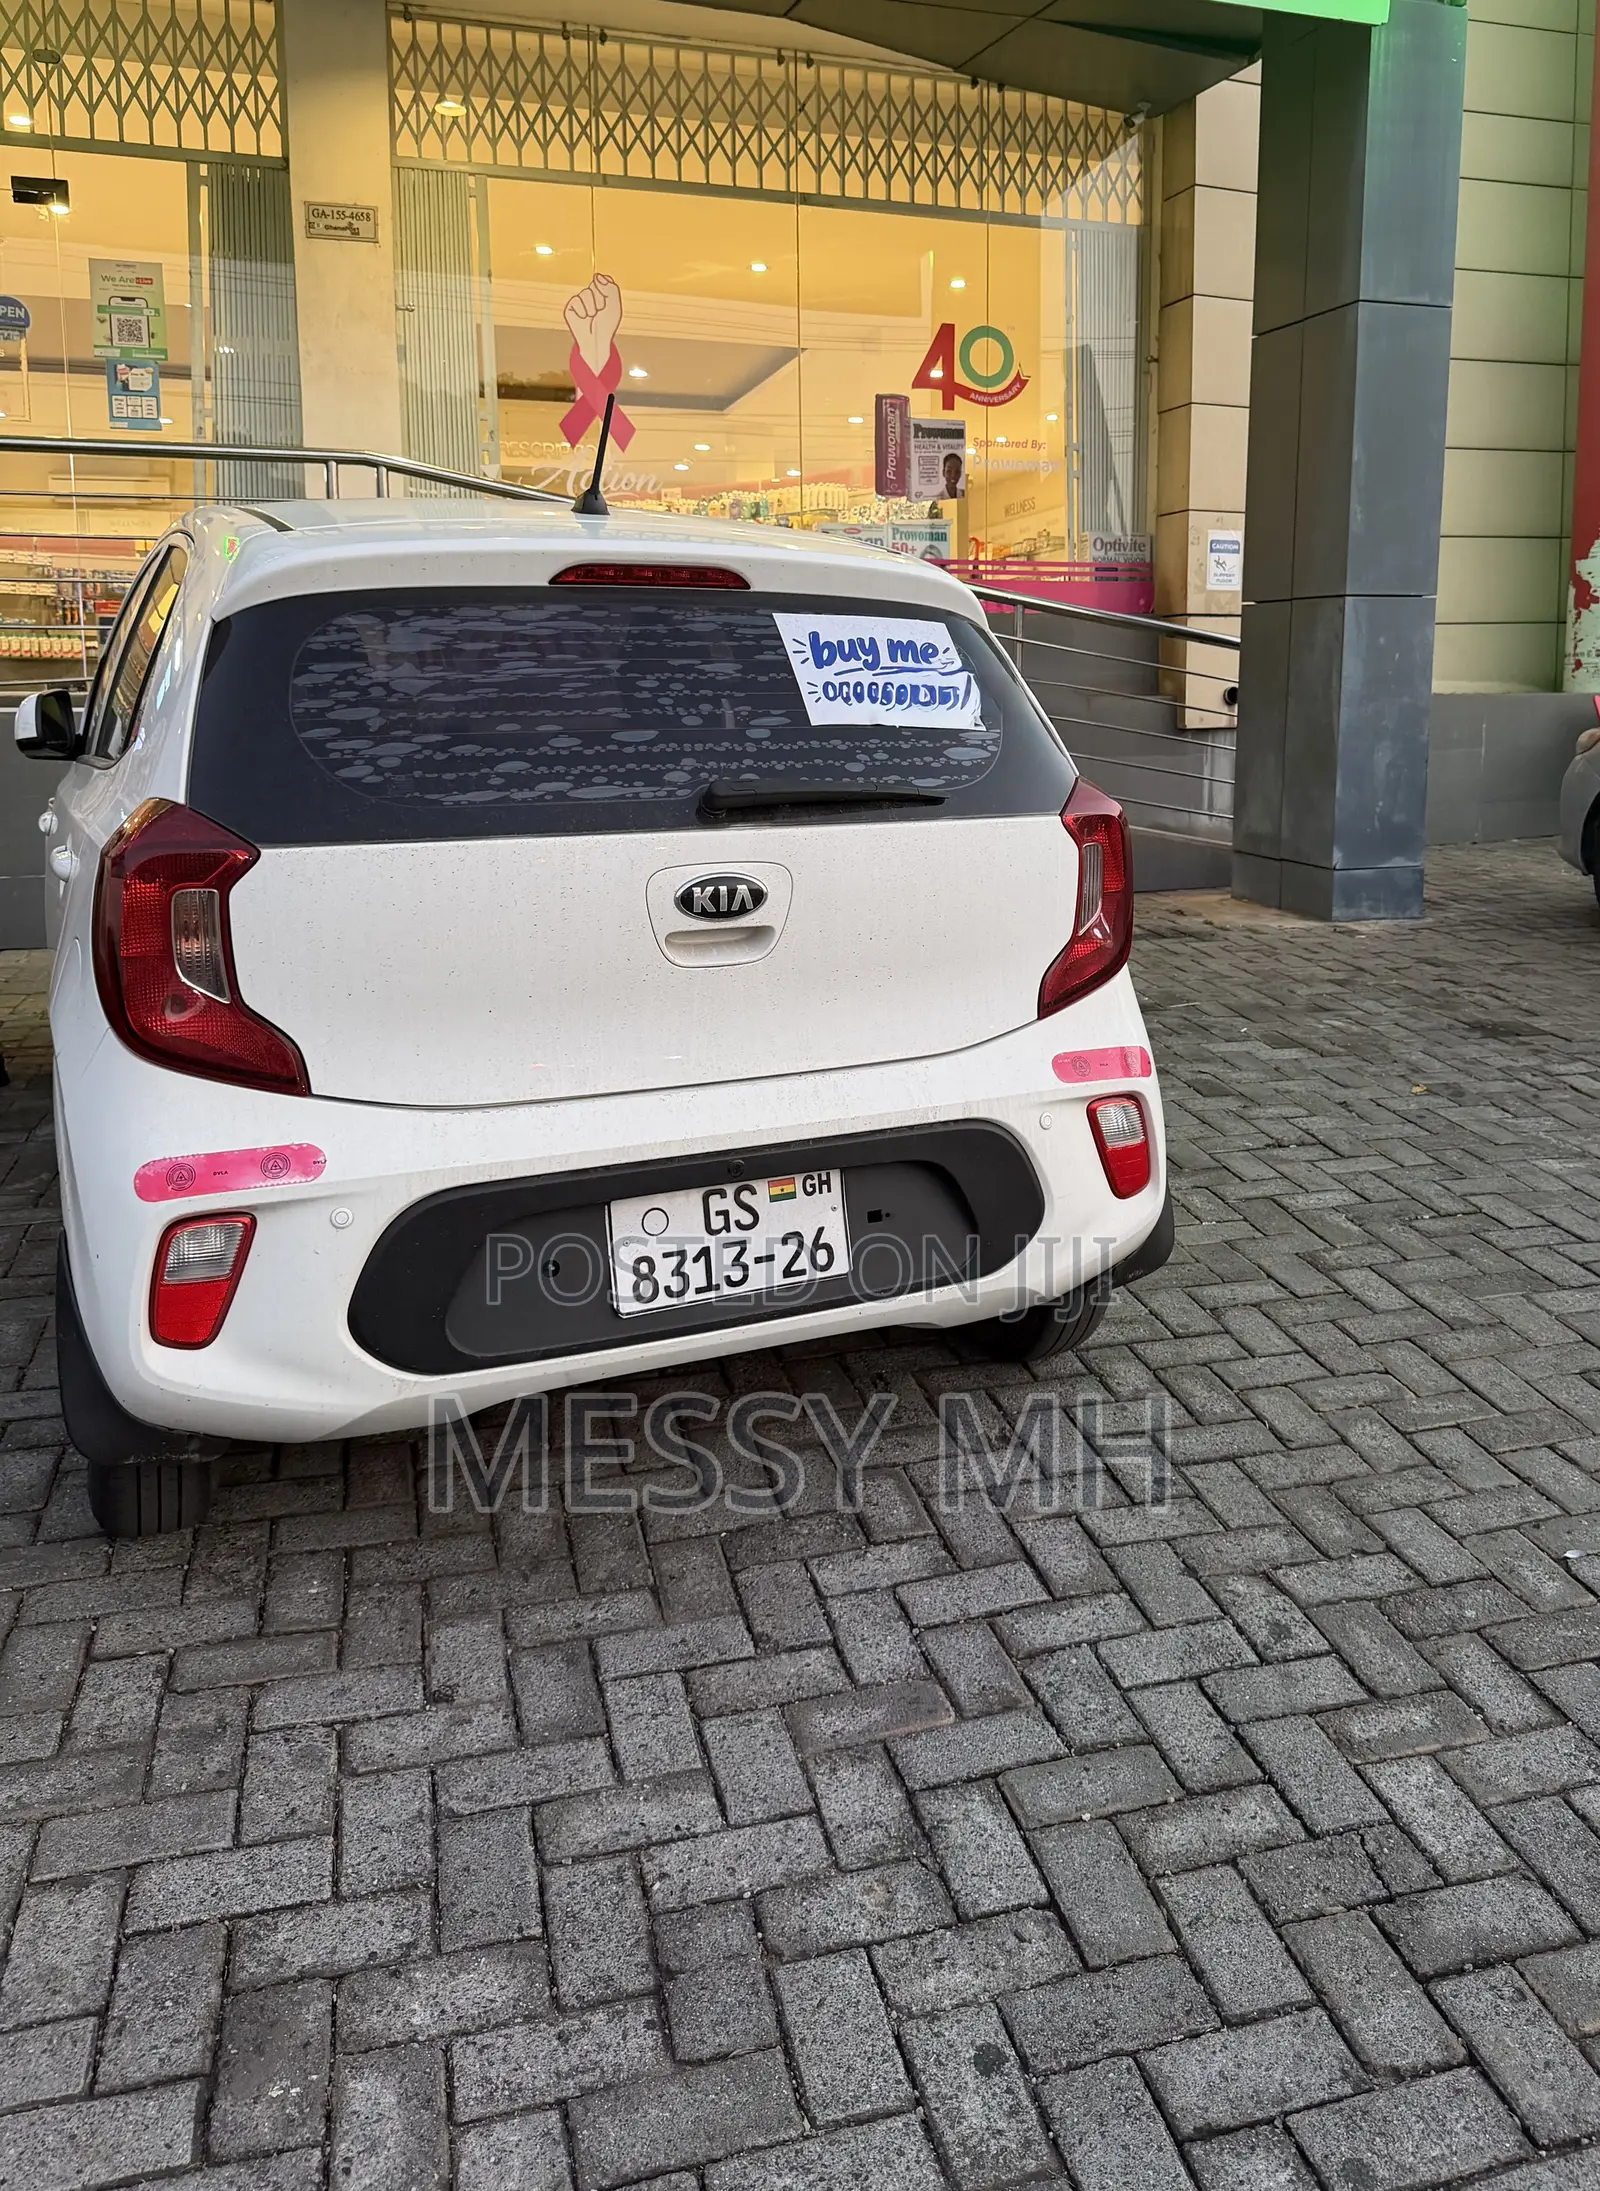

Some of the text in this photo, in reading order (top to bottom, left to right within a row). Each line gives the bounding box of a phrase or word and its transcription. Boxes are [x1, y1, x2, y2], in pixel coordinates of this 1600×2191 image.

[312, 208, 371, 222] GA-155-4658
[101, 274, 117, 283] We
[119, 276, 135, 284] Are
[0, 305, 25, 319] PEN
[912, 323, 1015, 411] 40
[969, 382, 1021, 403] ANNIVERSARY
[886, 406, 897, 480] Prowoman
[1030, 439, 1046, 451] By:
[1004, 497, 1036, 517] WELLNESS
[891, 527, 948, 542] Prowoman
[1093, 536, 1146, 556] Optivite
[1211, 542, 1239, 550] CAUTION
[808, 631, 939, 671] buy me
[691, 884, 754, 912] KIA
[702, 1171, 832, 1236] GS GH
[632, 1226, 835, 1304] 8313-26
